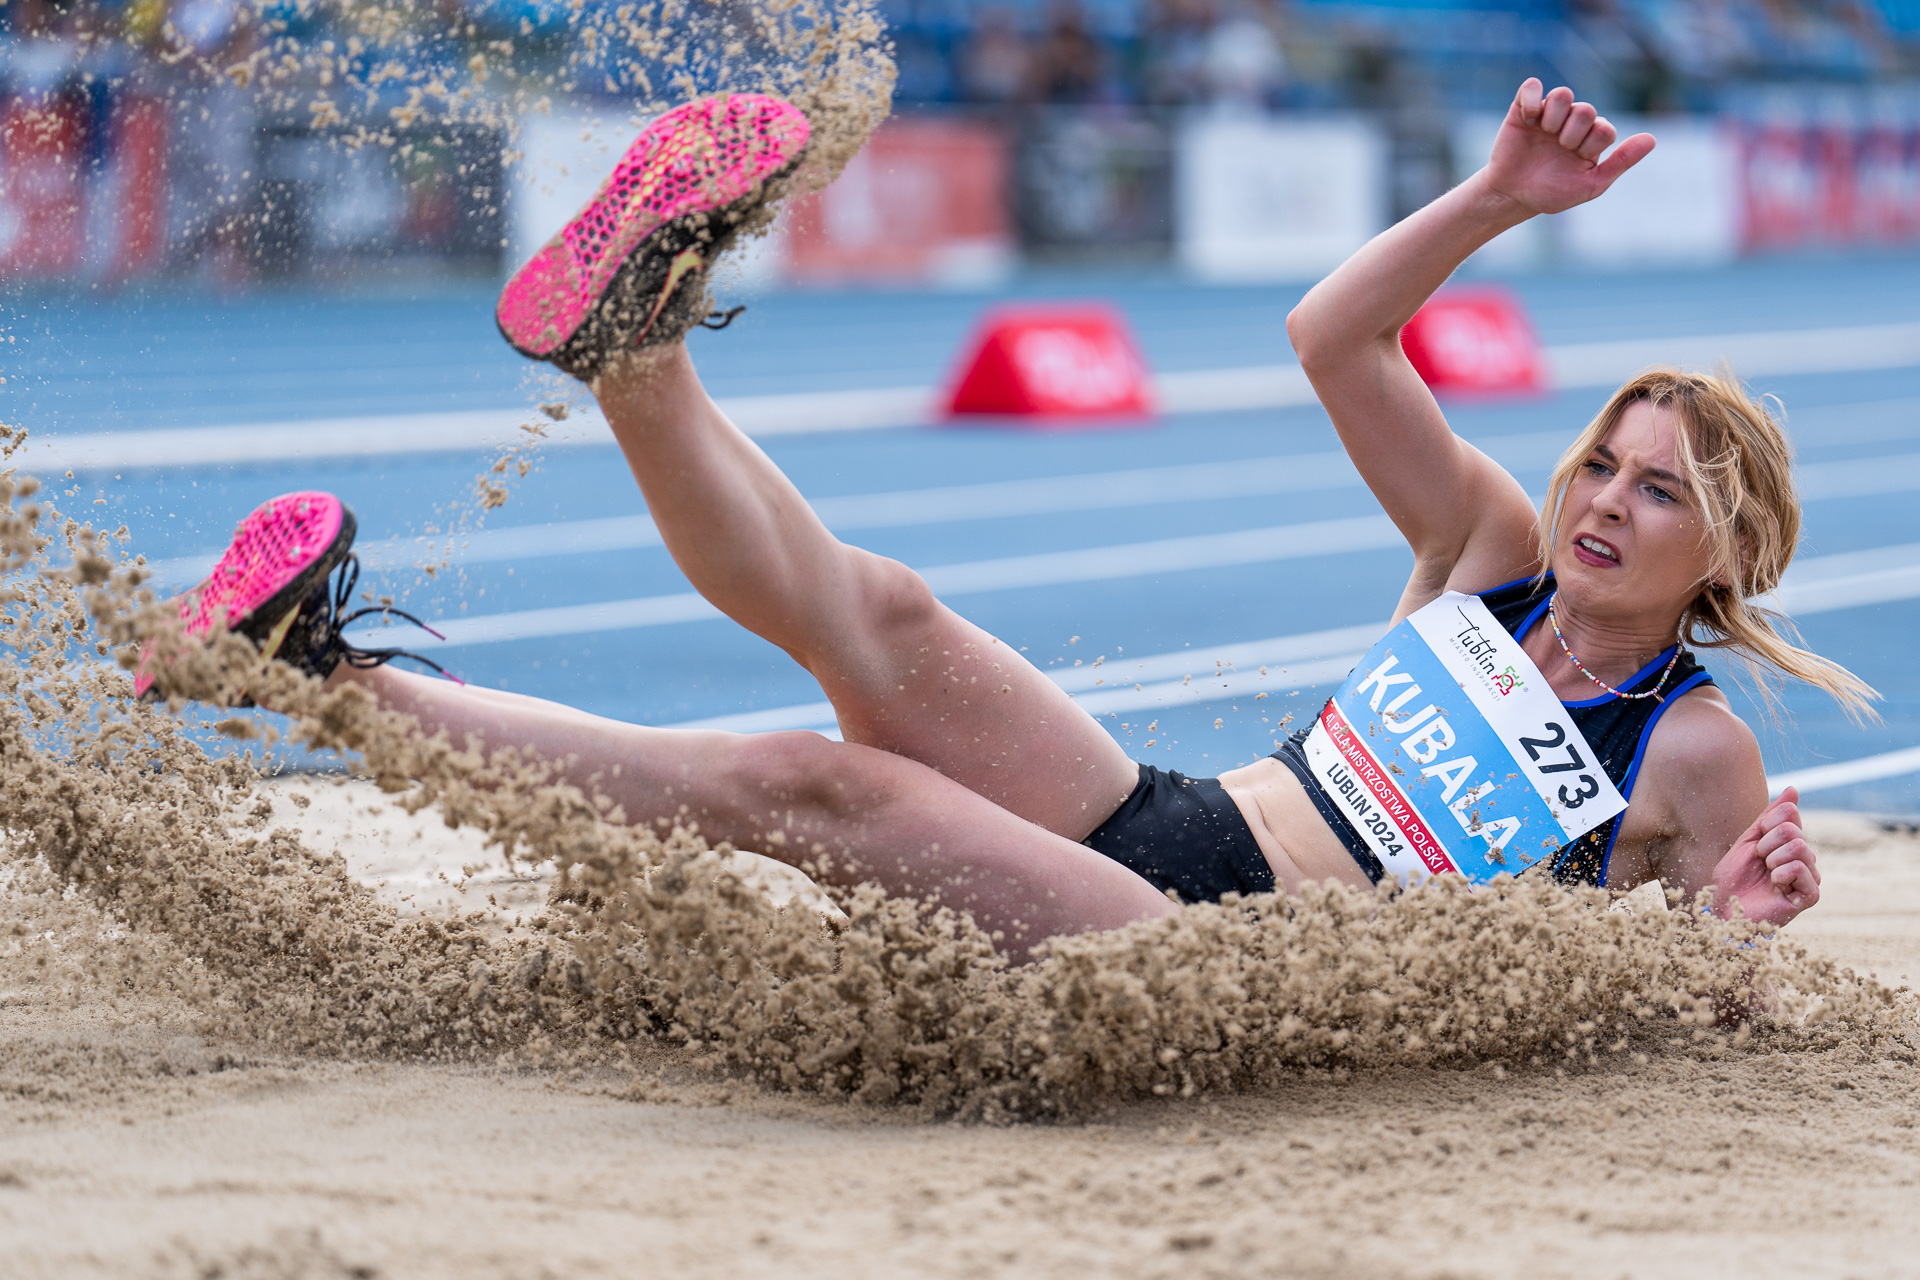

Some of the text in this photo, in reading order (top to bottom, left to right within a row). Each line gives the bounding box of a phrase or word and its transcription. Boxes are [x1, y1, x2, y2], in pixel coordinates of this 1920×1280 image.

[1448, 637, 1502, 702] MIASTO INSPIRACJI
[1325, 712, 1336, 728] 41.
[1347, 744, 1412, 826] MISTRZOSTWA
[1406, 823, 1445, 870] POLSKI
[1356, 654, 1522, 865] KUBALA
[1518, 721, 1600, 809] 273
[1326, 762, 1404, 857] LUBLIN 2024
